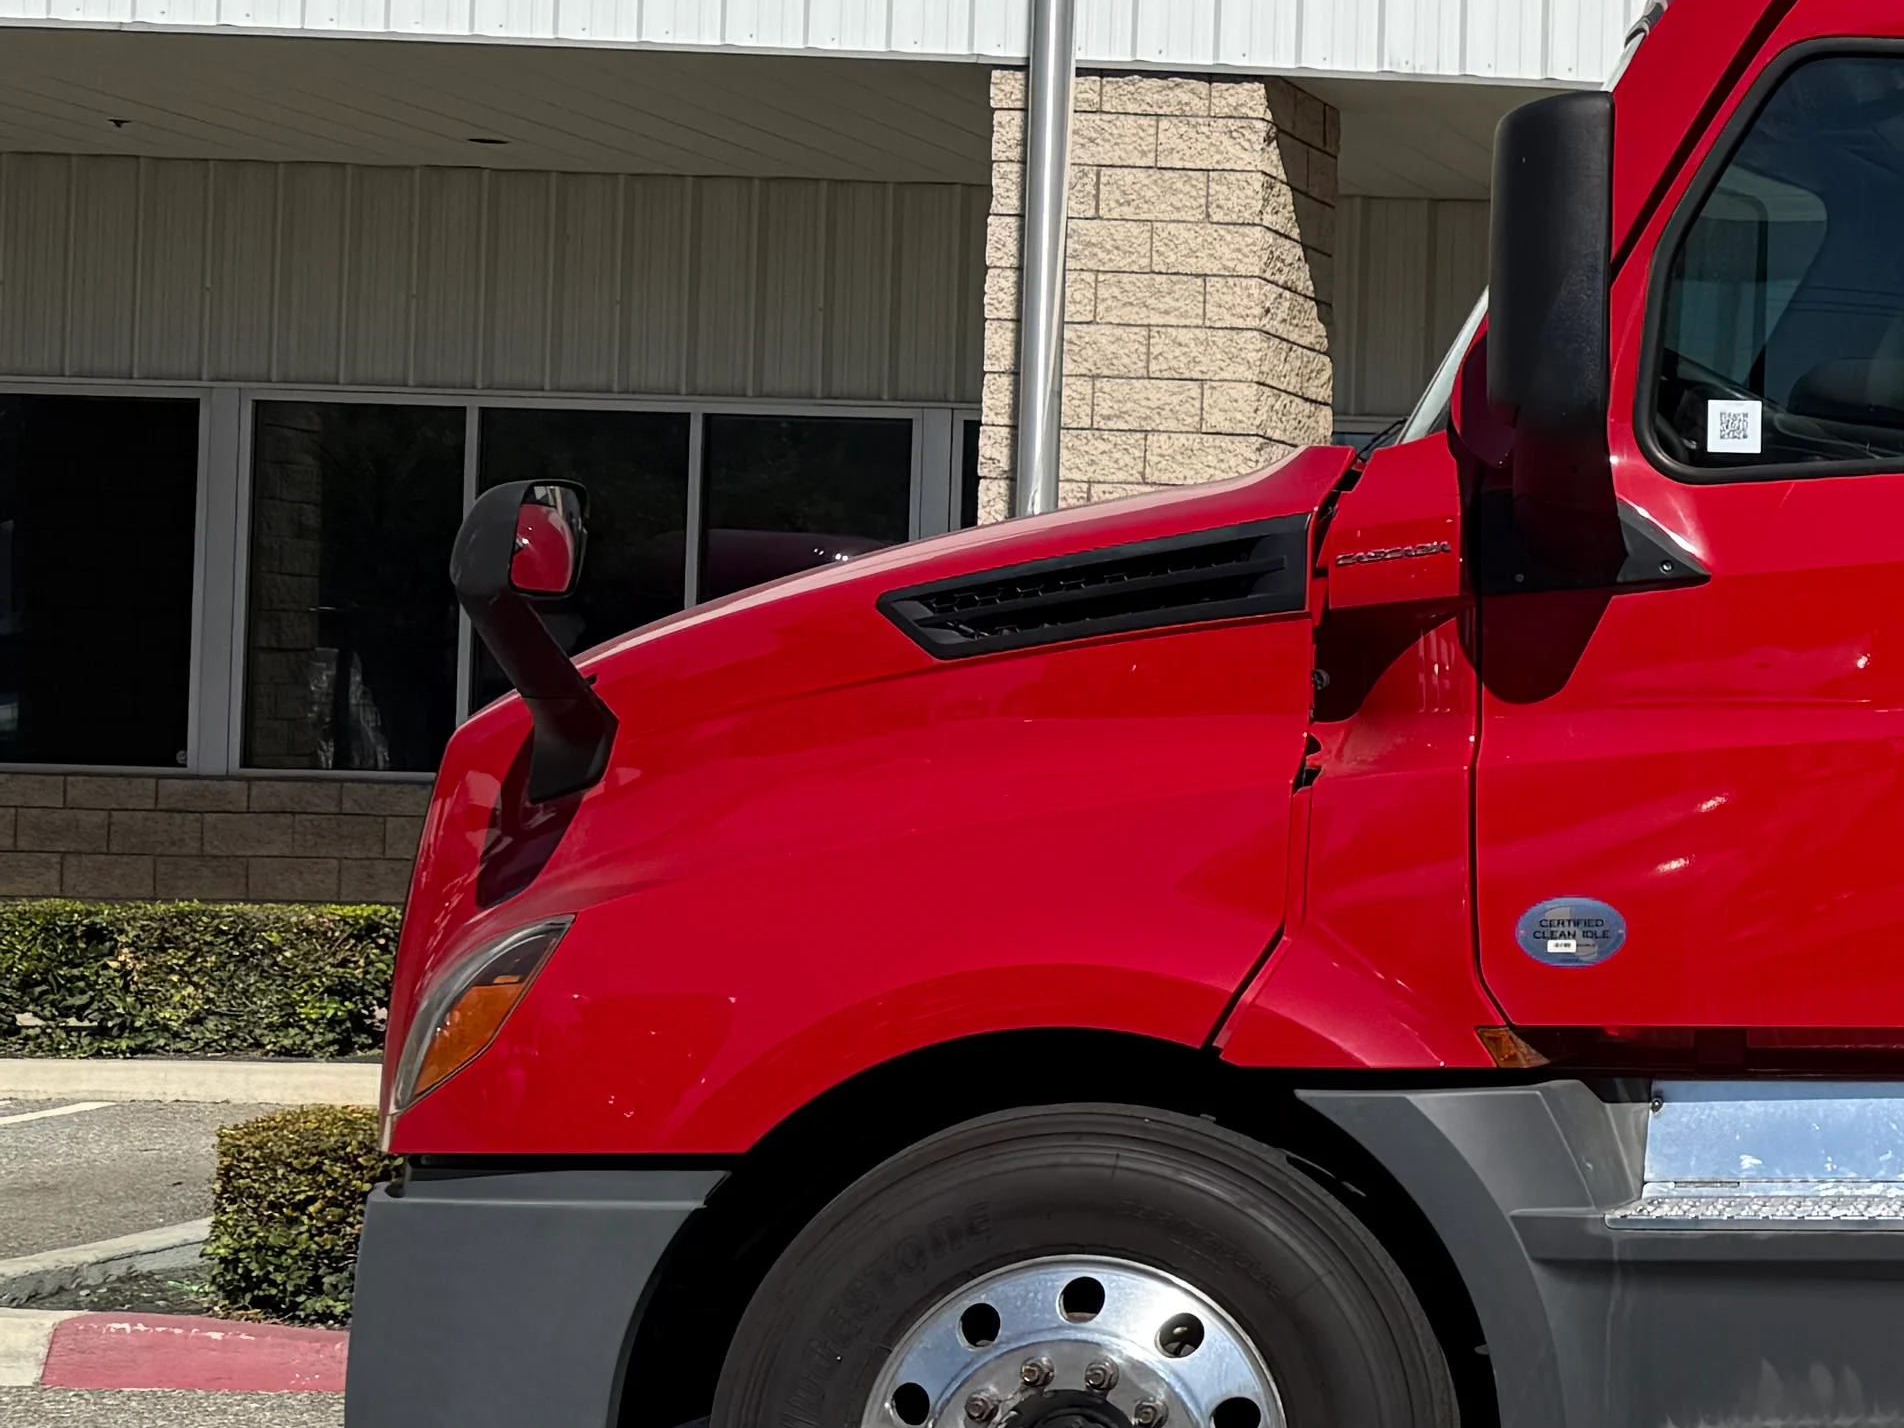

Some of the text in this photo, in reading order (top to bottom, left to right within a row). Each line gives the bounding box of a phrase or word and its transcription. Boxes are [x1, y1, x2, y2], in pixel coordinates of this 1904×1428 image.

[1539, 918, 1604, 928] CERTIFIED
[1532, 929, 1610, 940] CLEAN IDLE
